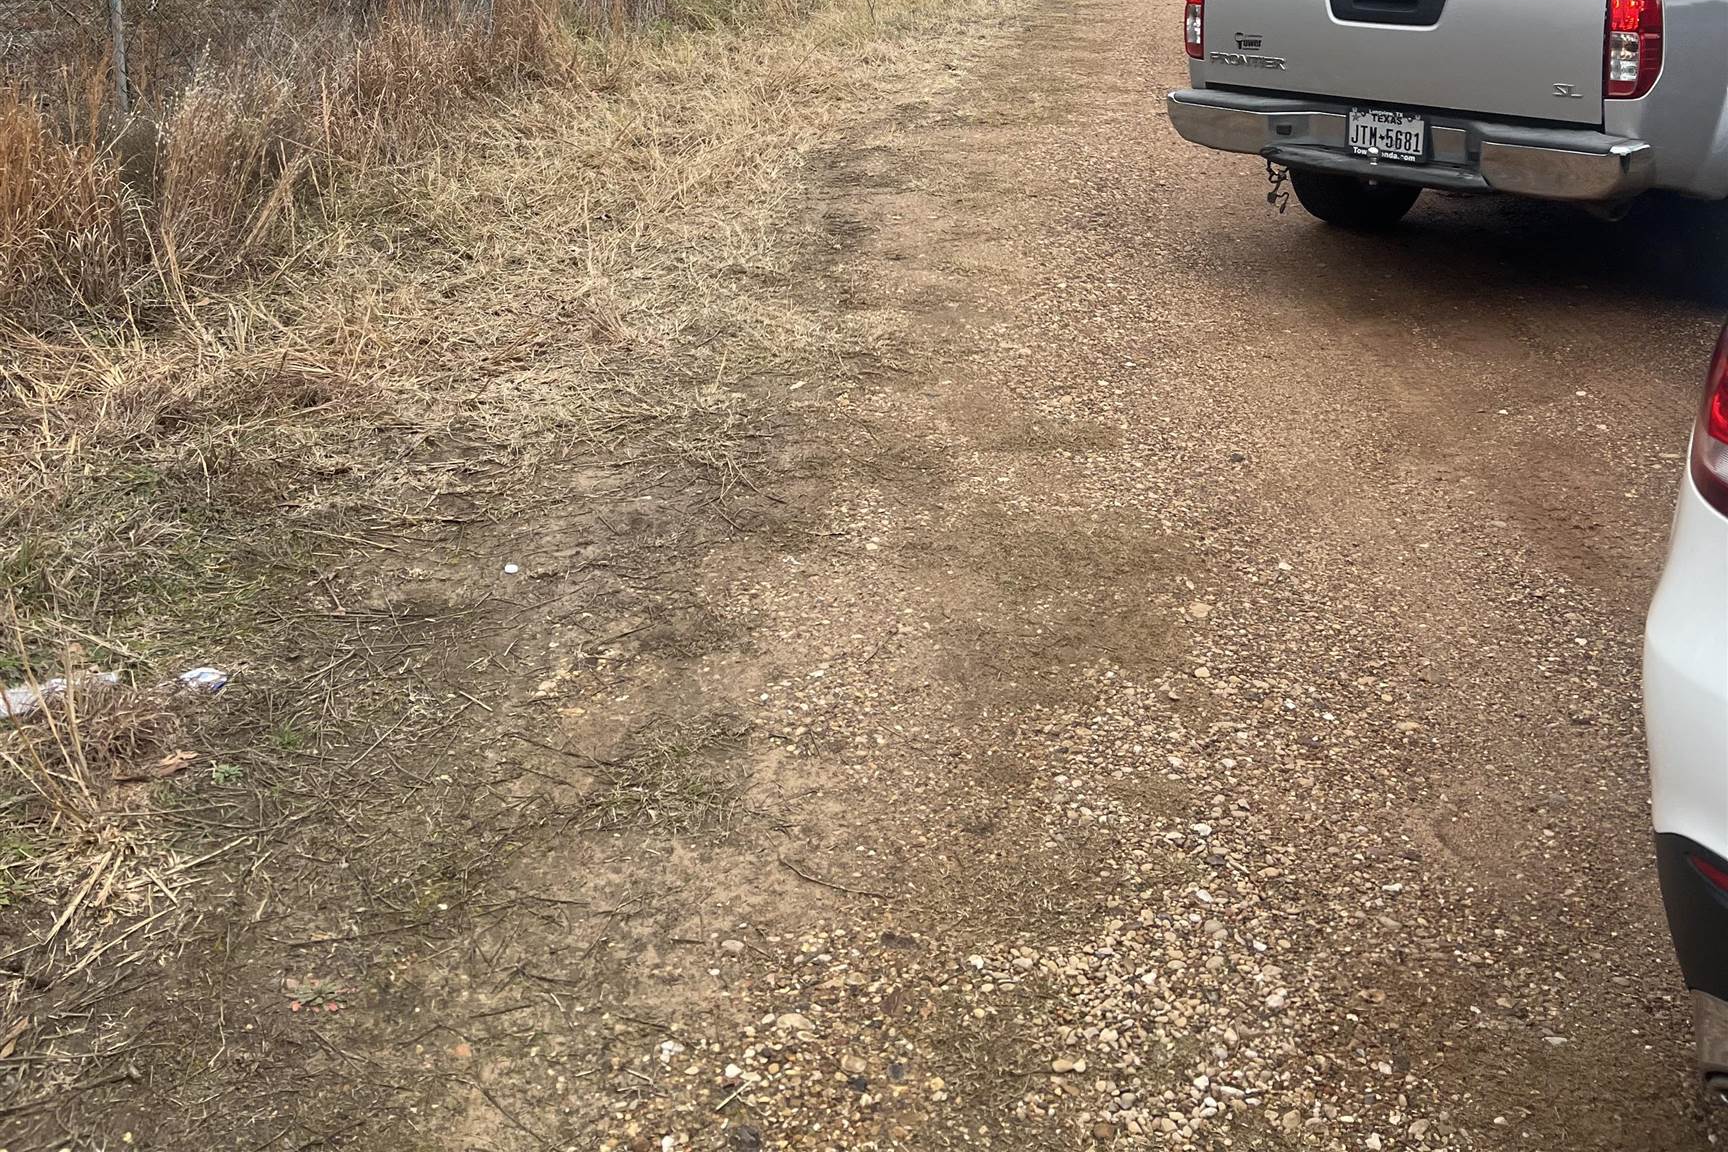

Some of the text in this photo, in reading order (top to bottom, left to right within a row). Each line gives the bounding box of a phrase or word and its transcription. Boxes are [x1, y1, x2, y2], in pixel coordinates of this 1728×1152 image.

[1209, 51, 1286, 70] FRONTIER
[1552, 83, 1584, 98] SL
[1371, 113, 1402, 125] TEXAS
